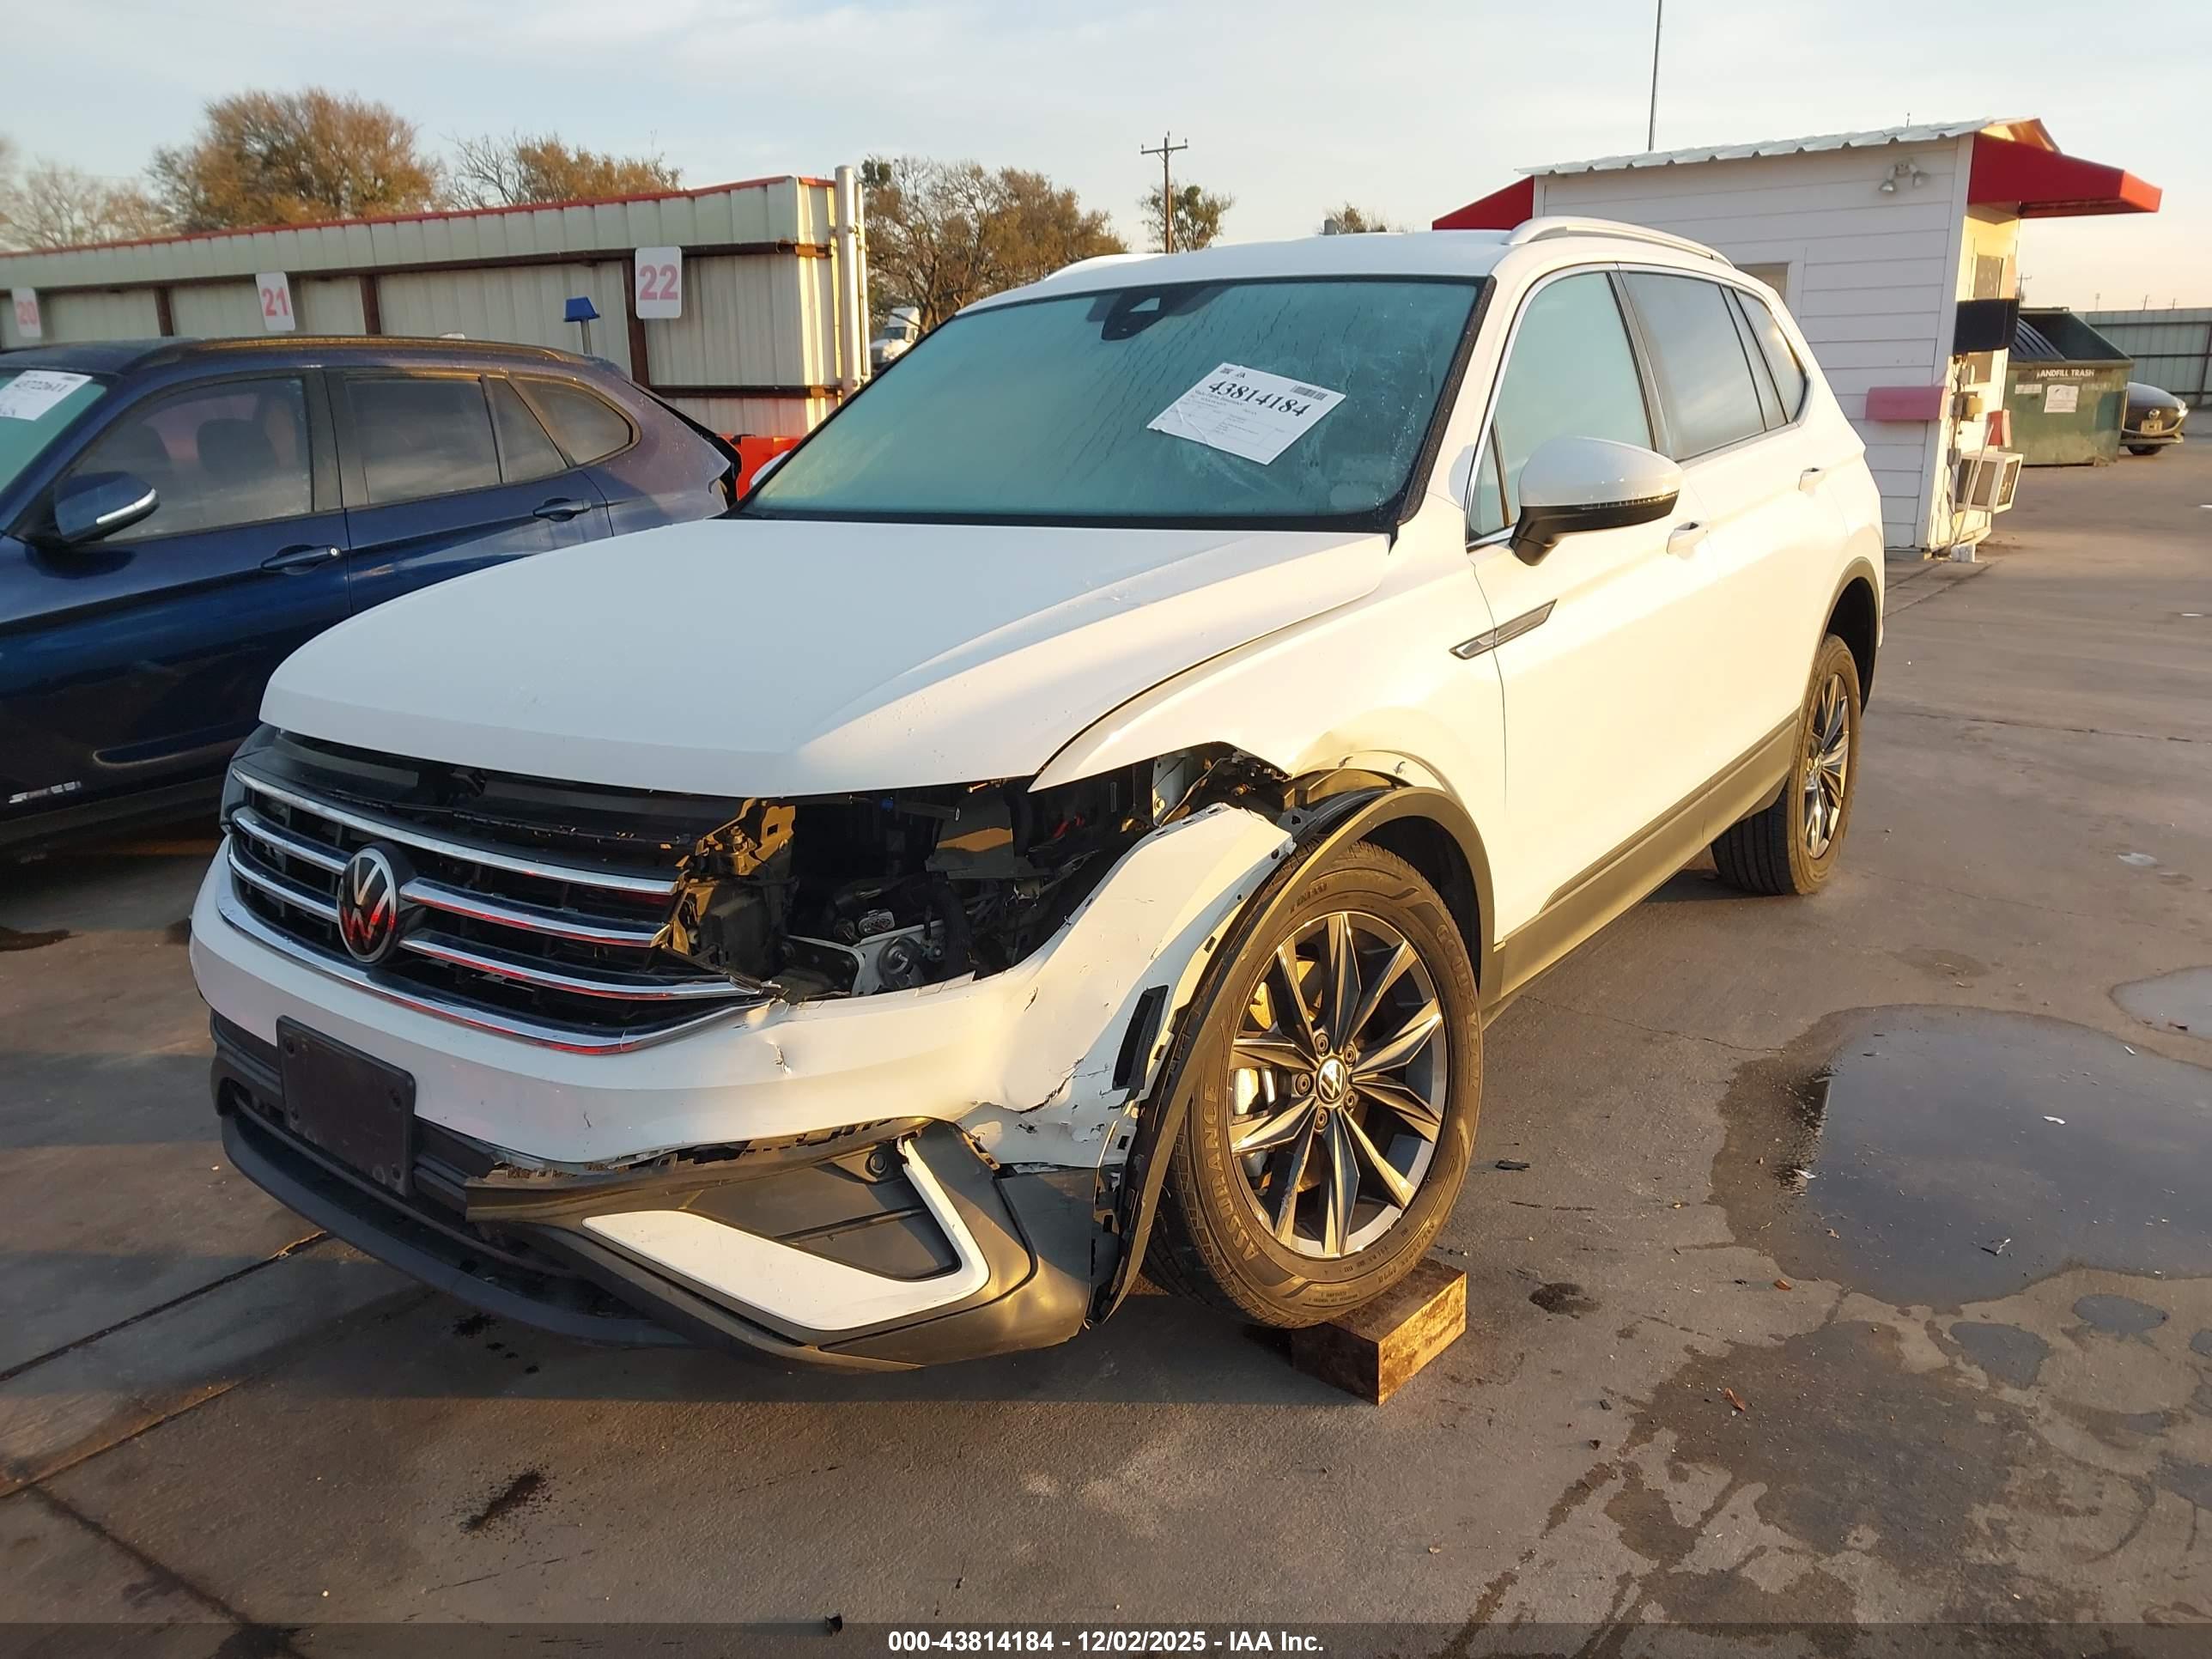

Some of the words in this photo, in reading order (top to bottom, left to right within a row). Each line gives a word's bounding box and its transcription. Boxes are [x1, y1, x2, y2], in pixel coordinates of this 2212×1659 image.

[639, 264, 678, 301] 22
[261, 287, 289, 317] 21
[2071, 368, 2095, 377] TRASH
[1208, 380, 1312, 417] 43814184
[1202, 1083, 1259, 1261] ASSURANCE
